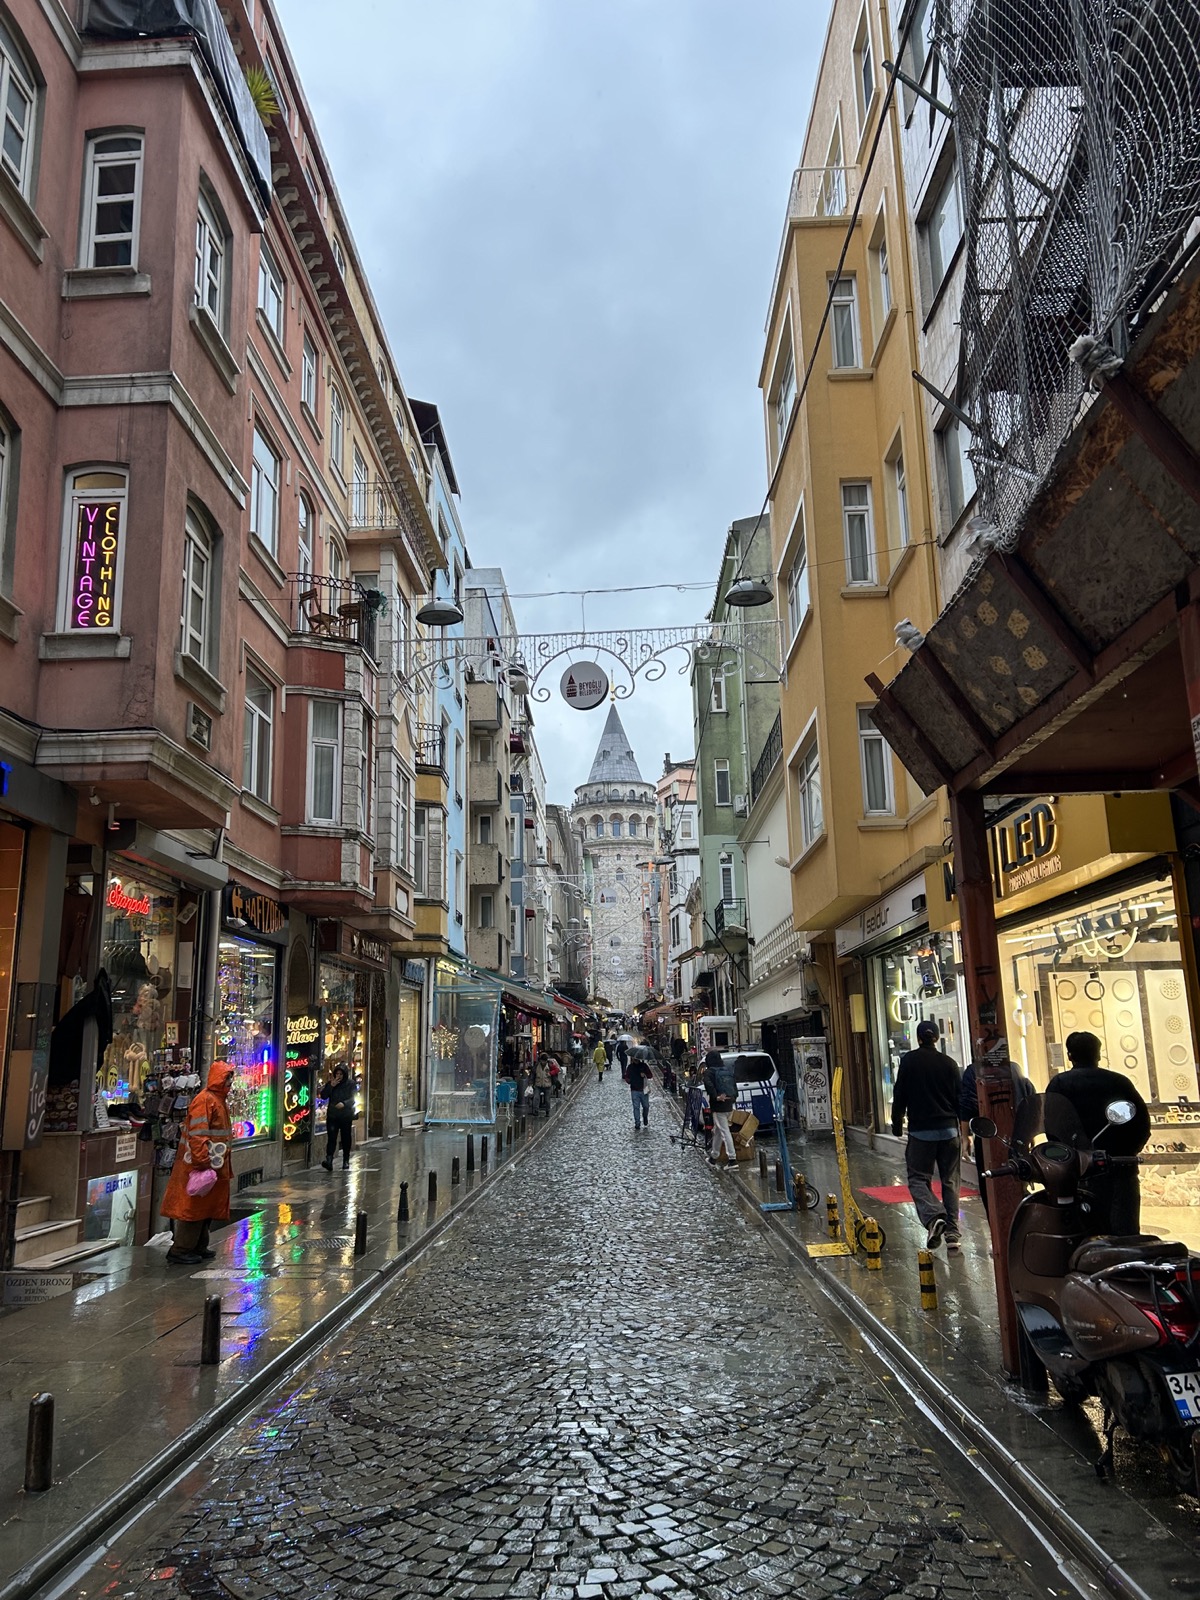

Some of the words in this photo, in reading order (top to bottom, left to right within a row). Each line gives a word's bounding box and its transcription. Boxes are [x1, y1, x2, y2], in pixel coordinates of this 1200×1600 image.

[76, 507, 99, 626] VINTAGE
[95, 506, 117, 626] CLOTHING
[579, 680, 602, 690] BEYOĞLU
[1000, 803, 1058, 873] LED
[866, 907, 889, 935] seldur
[105, 1174, 132, 1194] ELEKTRİK
[6, 1277, 38, 1286] ÖZDEN
[40, 1277, 71, 1286] BRONZ
[1169, 1375, 1195, 1394] 34
